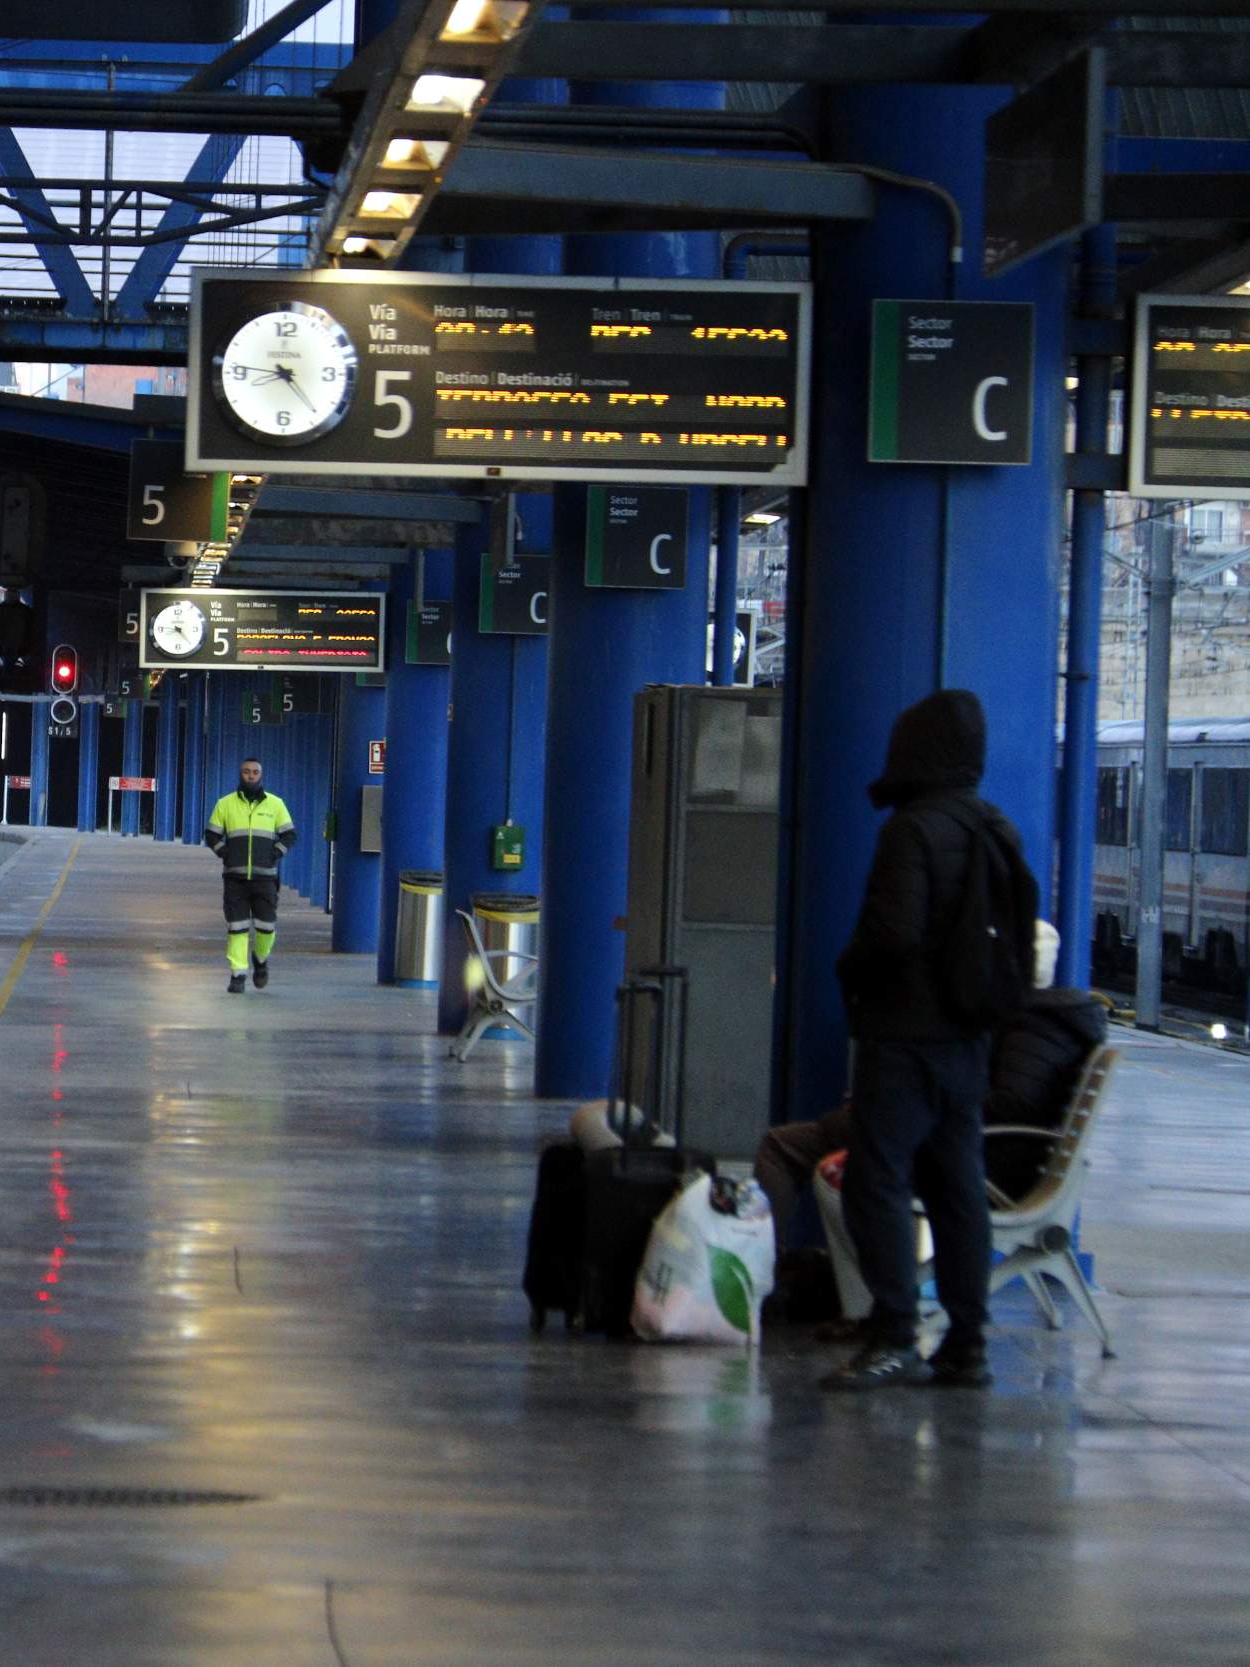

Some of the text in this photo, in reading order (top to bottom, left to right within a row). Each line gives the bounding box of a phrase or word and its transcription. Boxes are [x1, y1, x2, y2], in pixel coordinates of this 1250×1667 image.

[369, 303, 397, 321] Vía
[434, 305, 466, 318] Hora
[475, 305, 508, 318] Hora
[591, 308, 621, 320] Tren
[630, 308, 661, 321] Tren
[274, 321, 298, 338] 12
[908, 315, 954, 331] Sector
[368, 344, 431, 356] PLATFORM
[906, 335, 955, 350] Sector
[232, 364, 247, 381] 9
[322, 367, 336, 382] 3
[435, 371, 489, 385] Destino
[497, 371, 573, 386] Destinació
[374, 370, 413, 439] 5
[972, 376, 1009, 442] C
[276, 411, 291, 427] 6
[141, 484, 166, 526] 5
[609, 495, 638, 505] Sector
[609, 507, 639, 516] Sector
[649, 533, 672, 575] C
[498, 571, 522, 579] Sector
[529, 591, 548, 624] C
[125, 612, 138, 635] 5
[213, 628, 229, 656] 5
[121, 681, 130, 694] 5
[106, 704, 113, 714] 5
[282, 693, 294, 712] 5
[252, 708, 261, 723] 5
